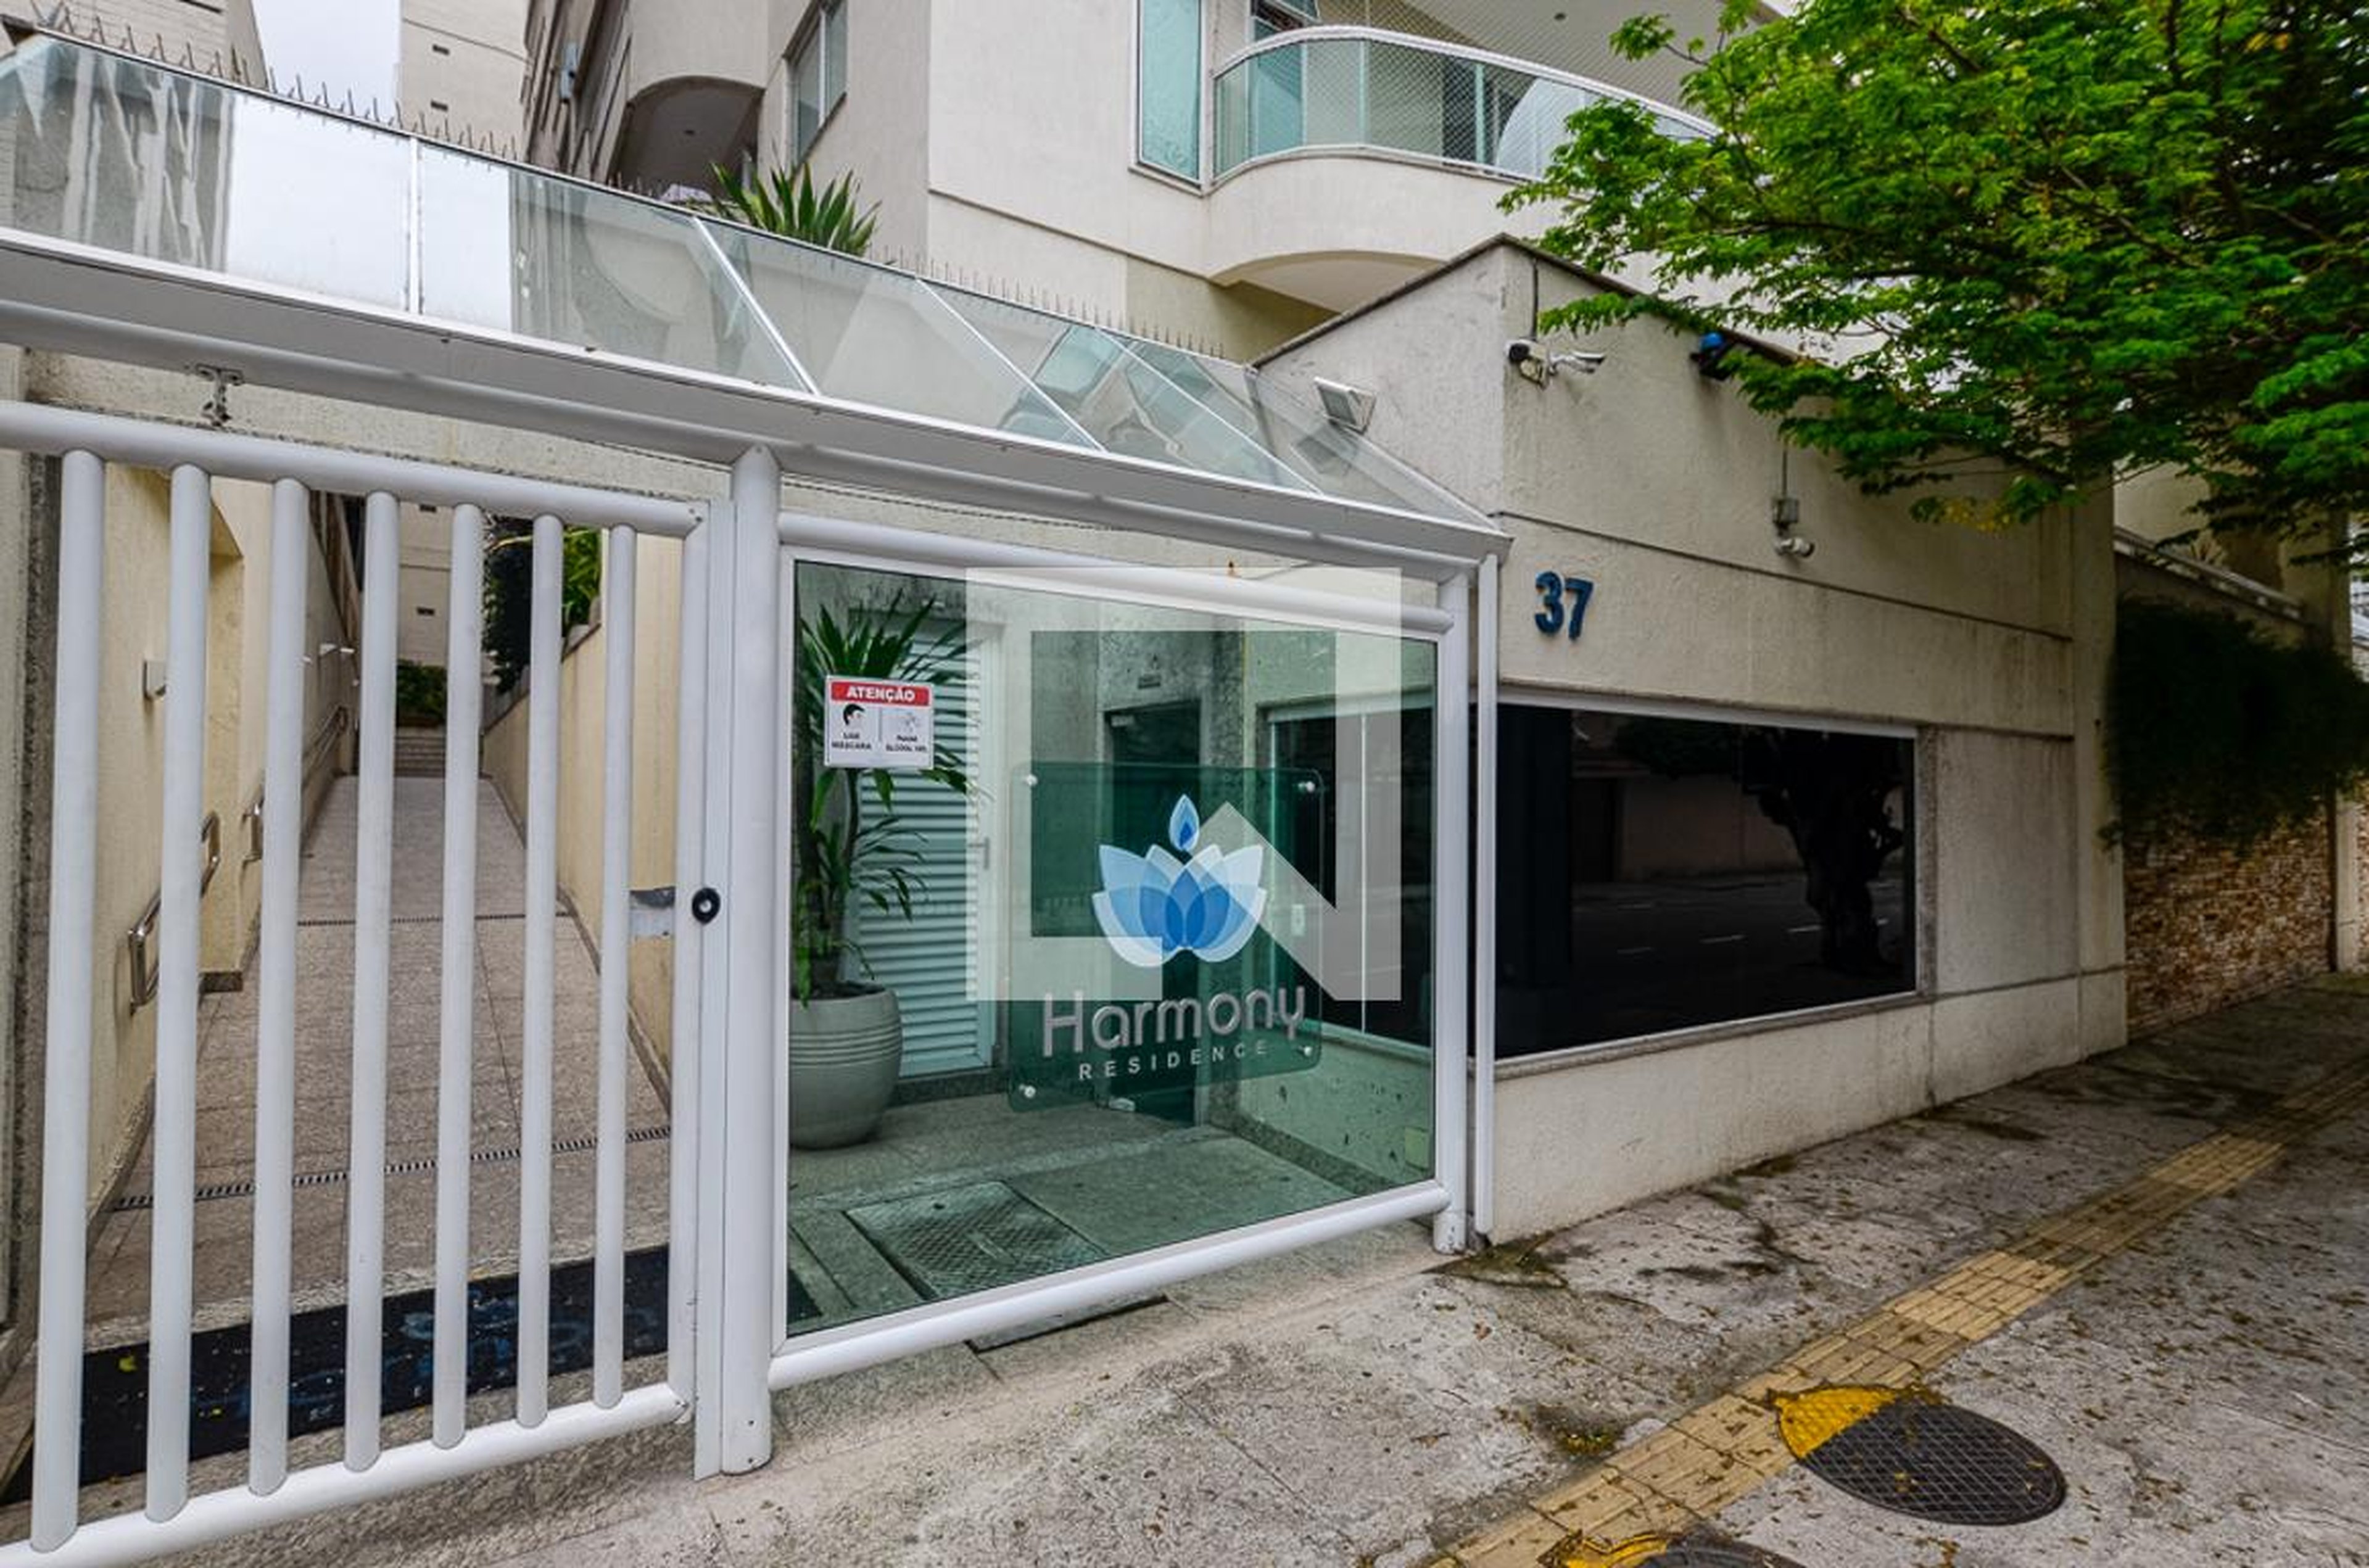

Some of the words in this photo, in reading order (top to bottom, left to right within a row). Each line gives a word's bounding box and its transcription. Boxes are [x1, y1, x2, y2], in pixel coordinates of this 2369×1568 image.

[1534, 571, 1594, 640] 37
[846, 685, 916, 702] ATENÇÃO
[1043, 985, 1306, 1057] Harmony
[1078, 1038, 1267, 1080] RESIDENCE
